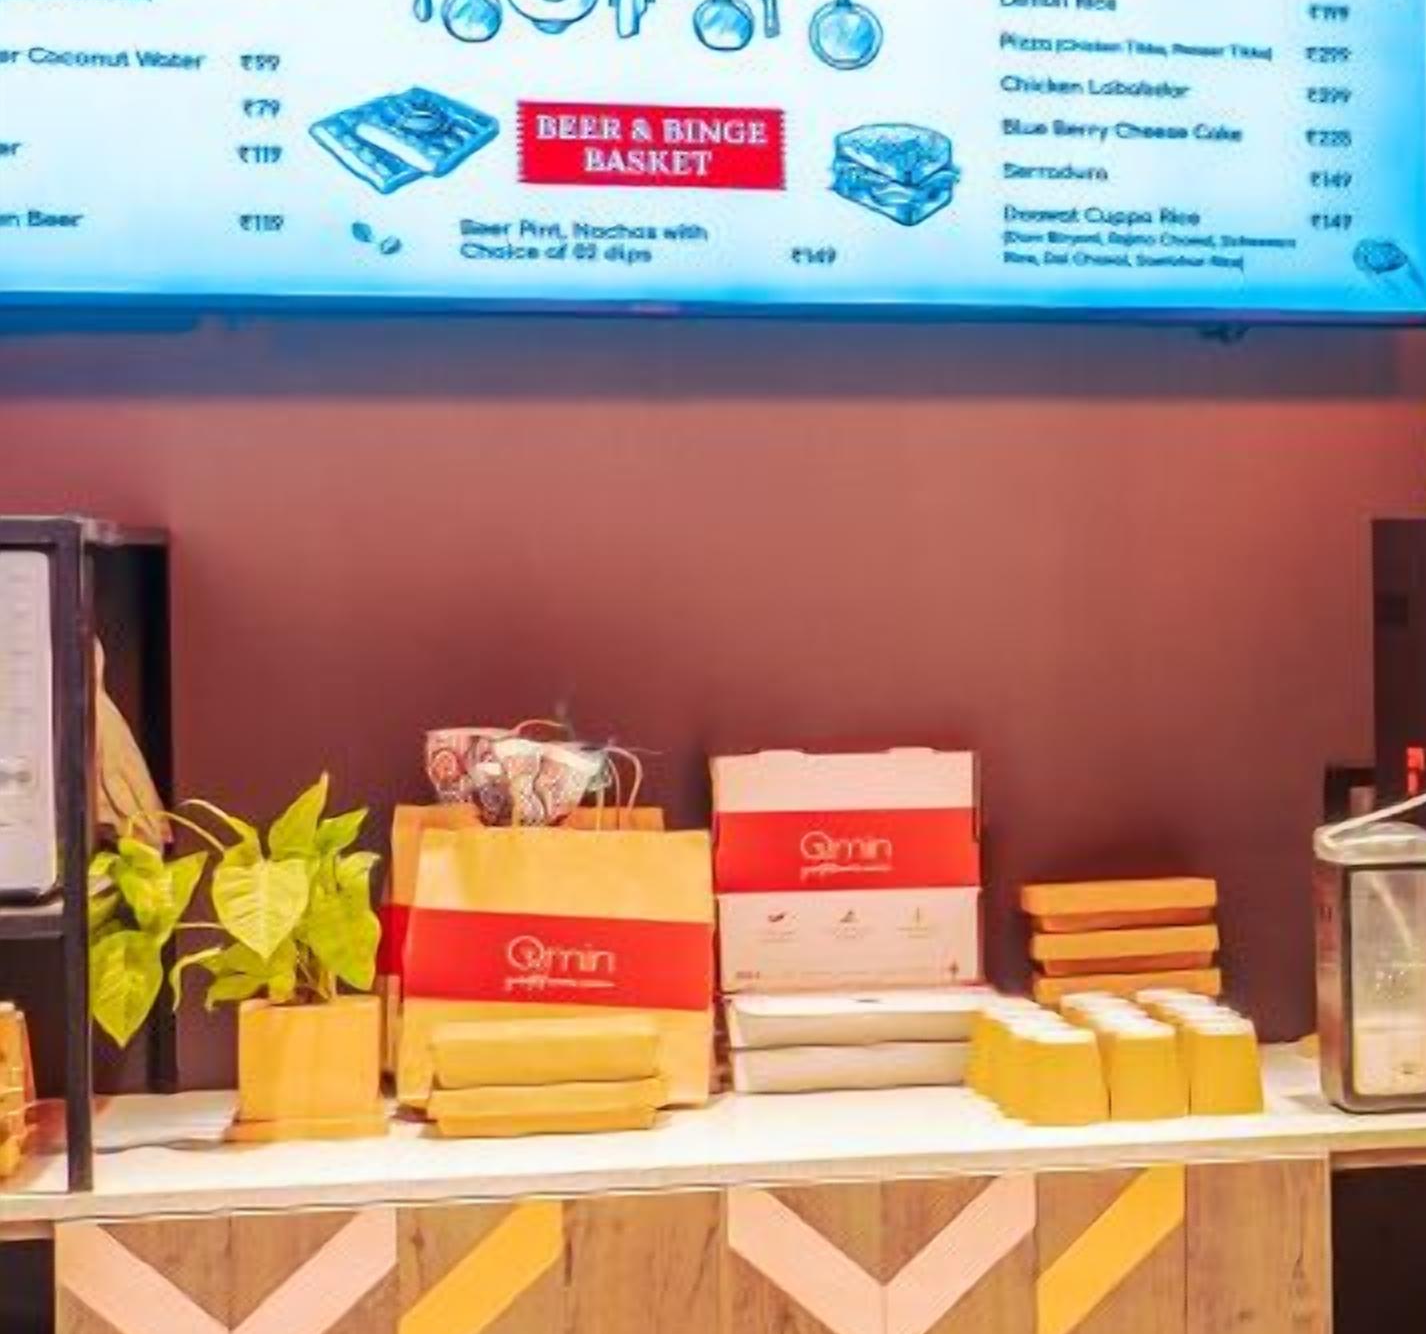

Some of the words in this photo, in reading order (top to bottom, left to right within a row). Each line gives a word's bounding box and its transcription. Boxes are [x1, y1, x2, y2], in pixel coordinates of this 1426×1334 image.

[1000, 75, 1084, 94] Chicken
[537, 115, 612, 140] BEER
[631, 118, 652, 142] &
[663, 119, 767, 144] BINGE
[1002, 119, 1048, 135] Blue
[1114, 123, 1189, 139] Cheese
[1192, 124, 1242, 142] Cake
[585, 147, 712, 176] BASKET
[662, 224, 708, 240] with
[460, 243, 540, 260] Choice
[544, 243, 568, 260] of
[604, 244, 652, 265] dips
